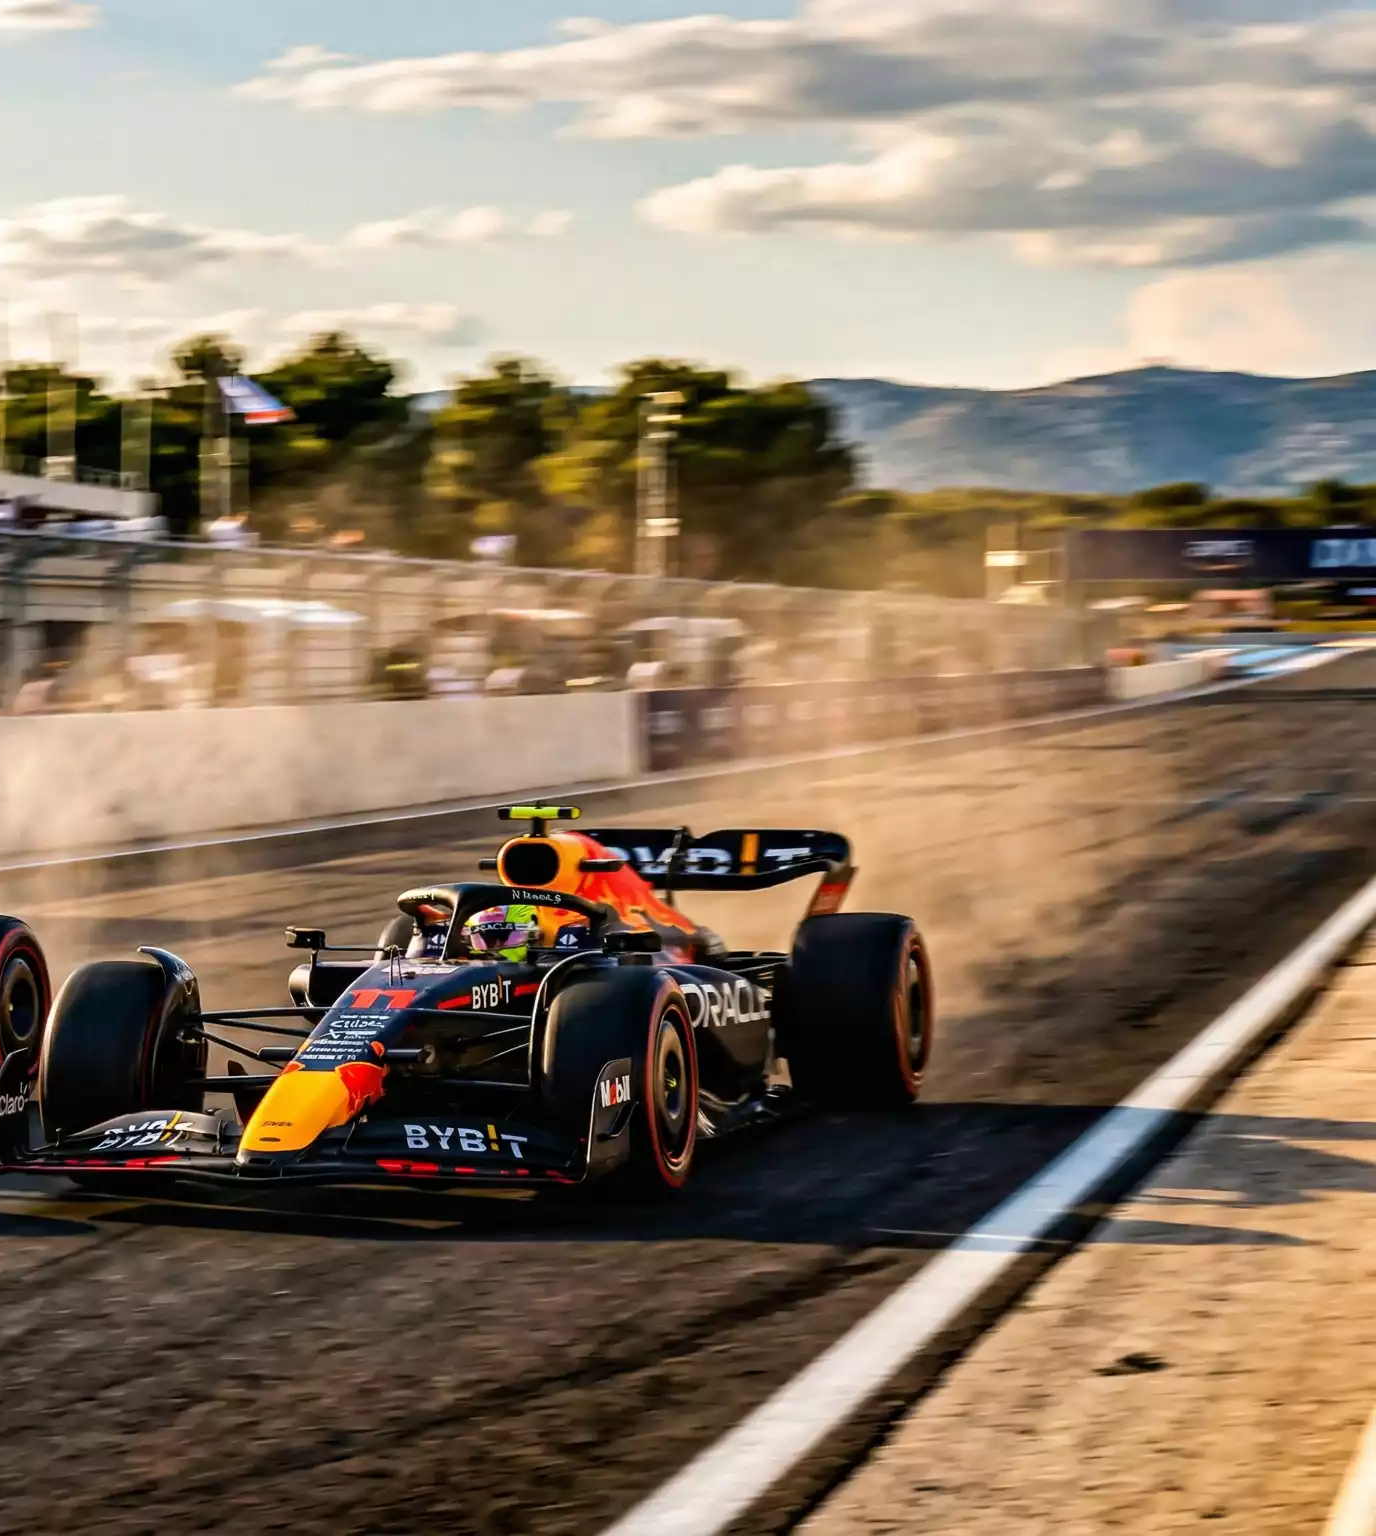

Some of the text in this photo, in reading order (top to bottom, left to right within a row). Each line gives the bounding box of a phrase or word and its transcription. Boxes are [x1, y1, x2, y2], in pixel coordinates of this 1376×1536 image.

[349, 989, 417, 1009] 11
[472, 976, 512, 1010] BYBIT
[600, 1075, 631, 1108] Mobil
